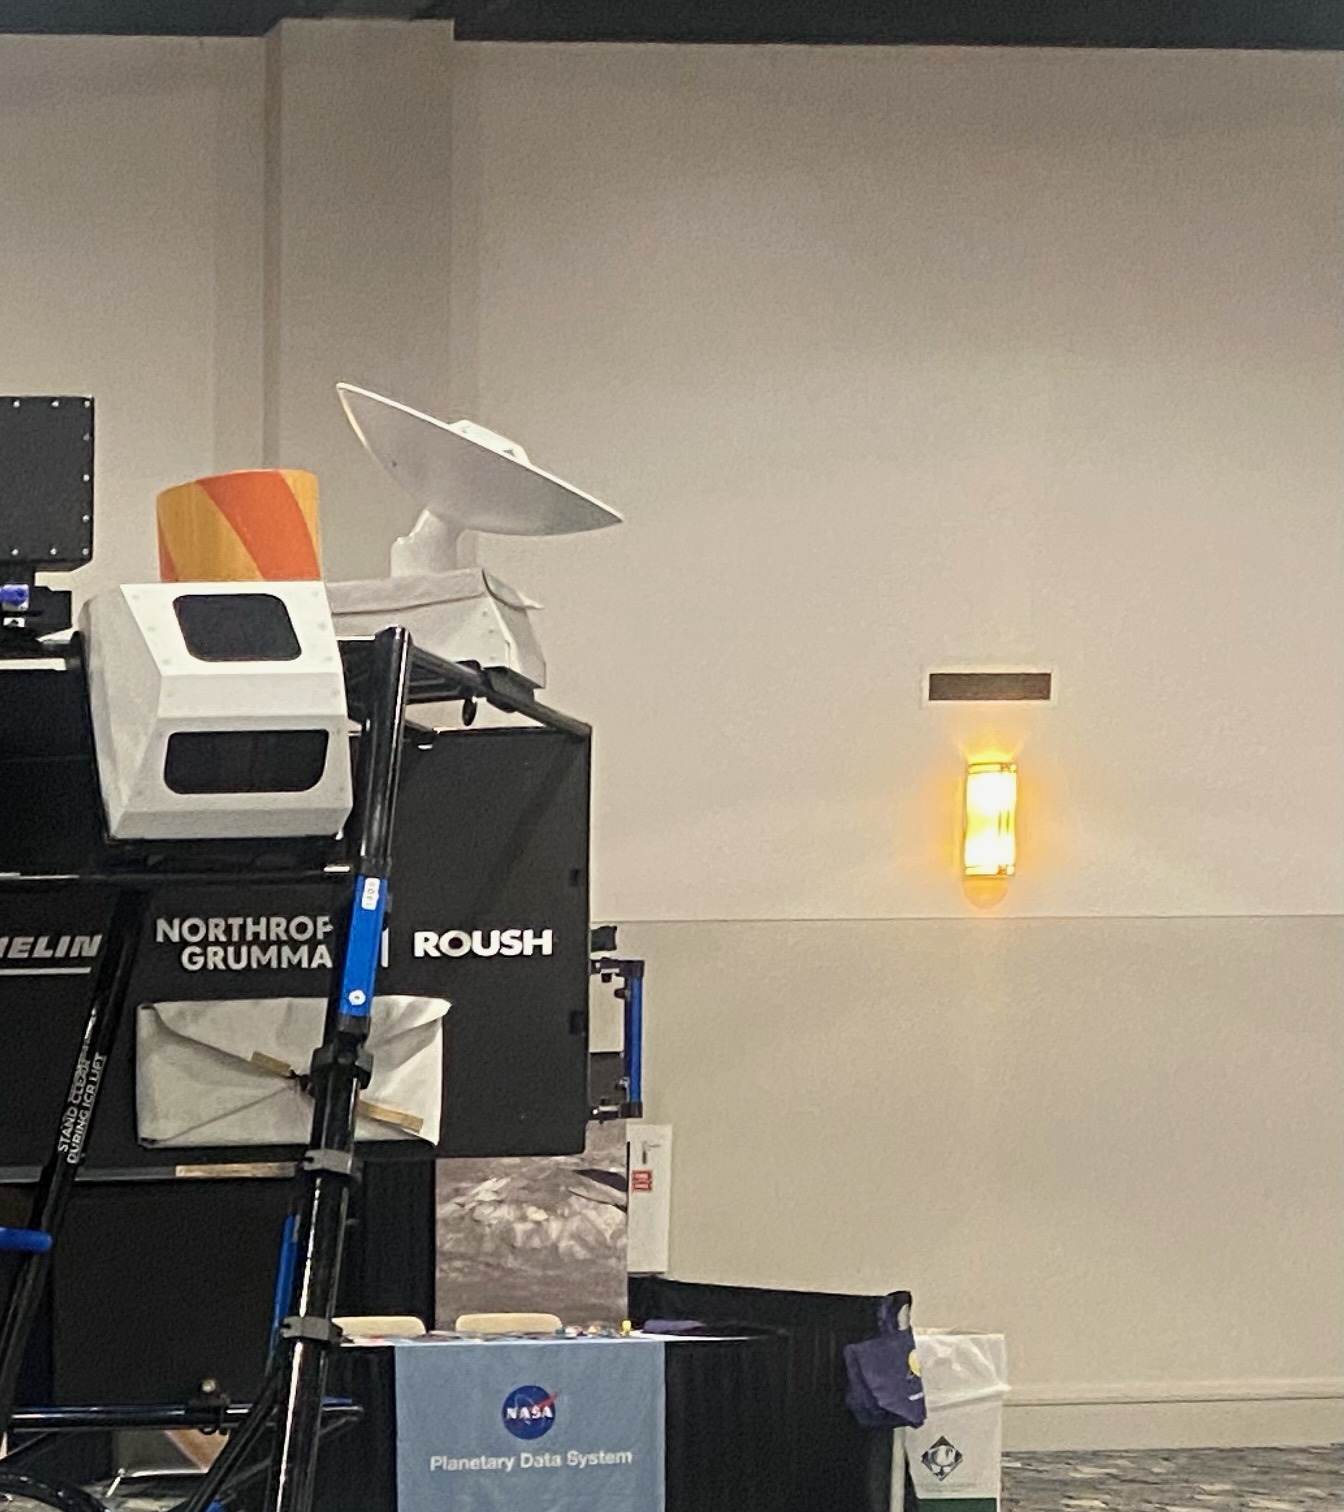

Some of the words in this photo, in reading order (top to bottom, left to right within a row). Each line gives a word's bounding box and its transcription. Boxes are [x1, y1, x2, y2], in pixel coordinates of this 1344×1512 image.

[180, 928, 389, 972] GRUMMA
[414, 929, 553, 957] ROUSH
[57, 1106, 78, 1153] STAND
[66, 1109, 89, 1165] DURING
[505, 1404, 553, 1420] NASA
[429, 1455, 515, 1472] Planetary
[520, 1452, 562, 1468] Data
[566, 1450, 633, 1468] System
